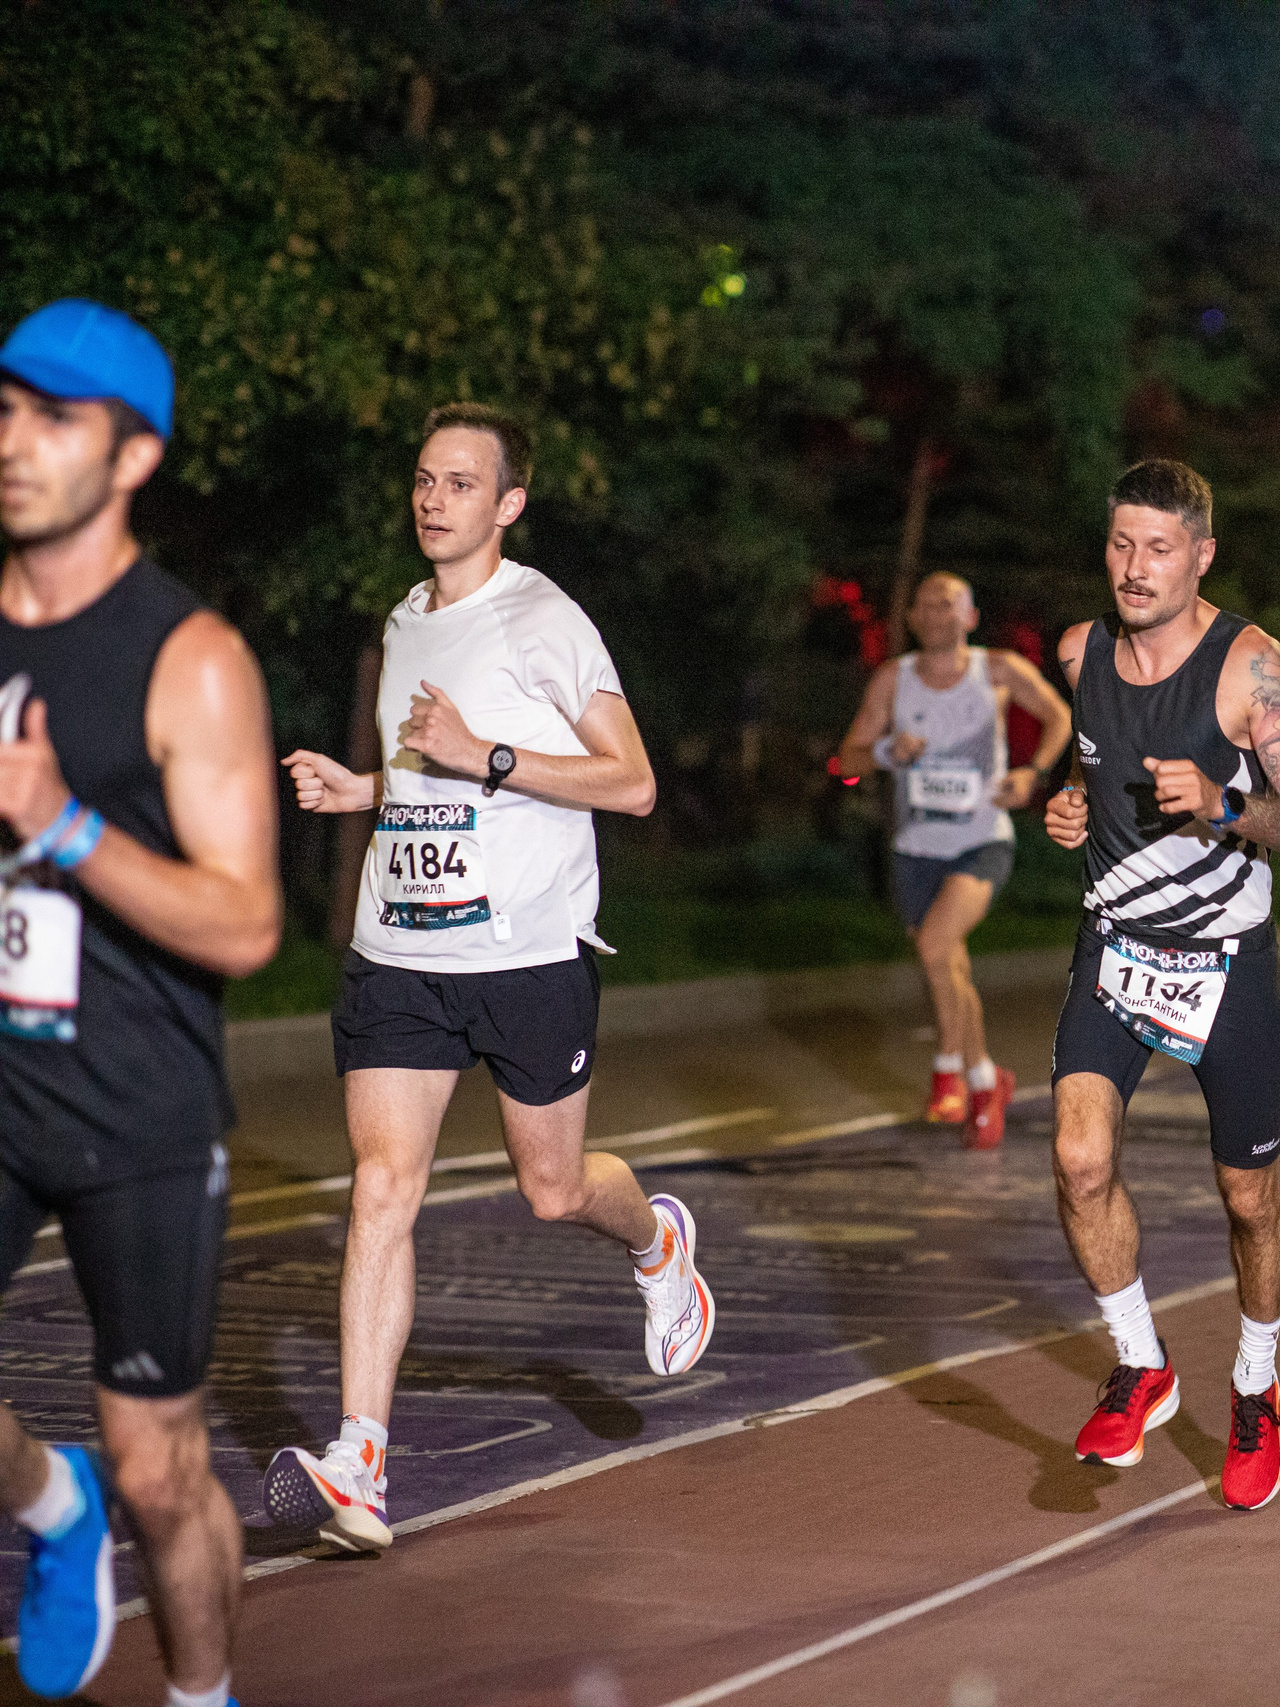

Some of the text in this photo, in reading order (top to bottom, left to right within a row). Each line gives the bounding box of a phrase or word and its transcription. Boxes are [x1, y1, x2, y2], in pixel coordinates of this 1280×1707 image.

[388, 841, 468, 880] 4184
[402, 883, 446, 895] КИРИЛЛ
[1118, 991, 1188, 1024] КОНСТАНТИН
